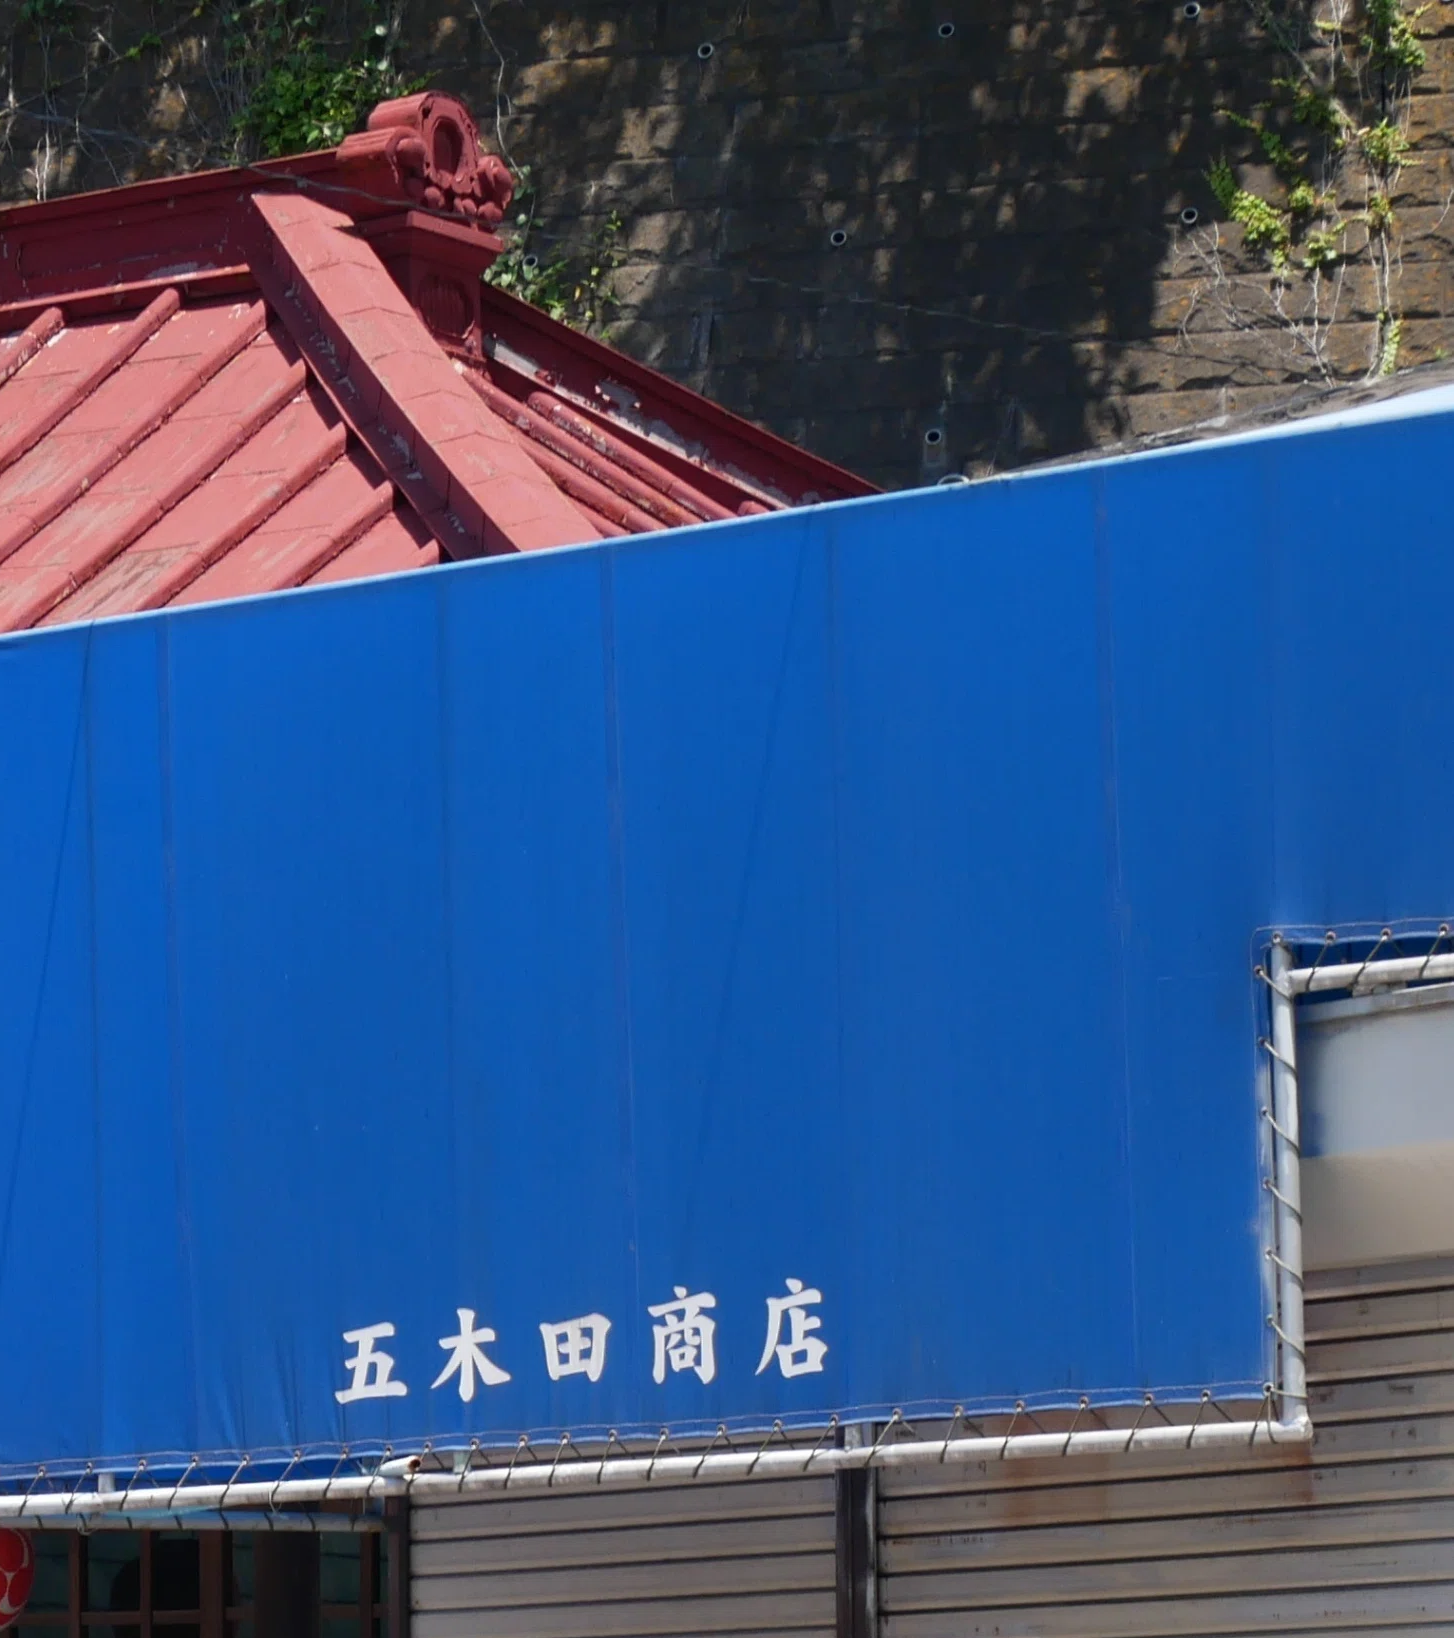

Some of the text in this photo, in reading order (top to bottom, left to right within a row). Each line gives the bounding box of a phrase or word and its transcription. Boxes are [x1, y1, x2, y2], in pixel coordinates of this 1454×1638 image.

[334, 1277, 829, 1405] 五木田商店
